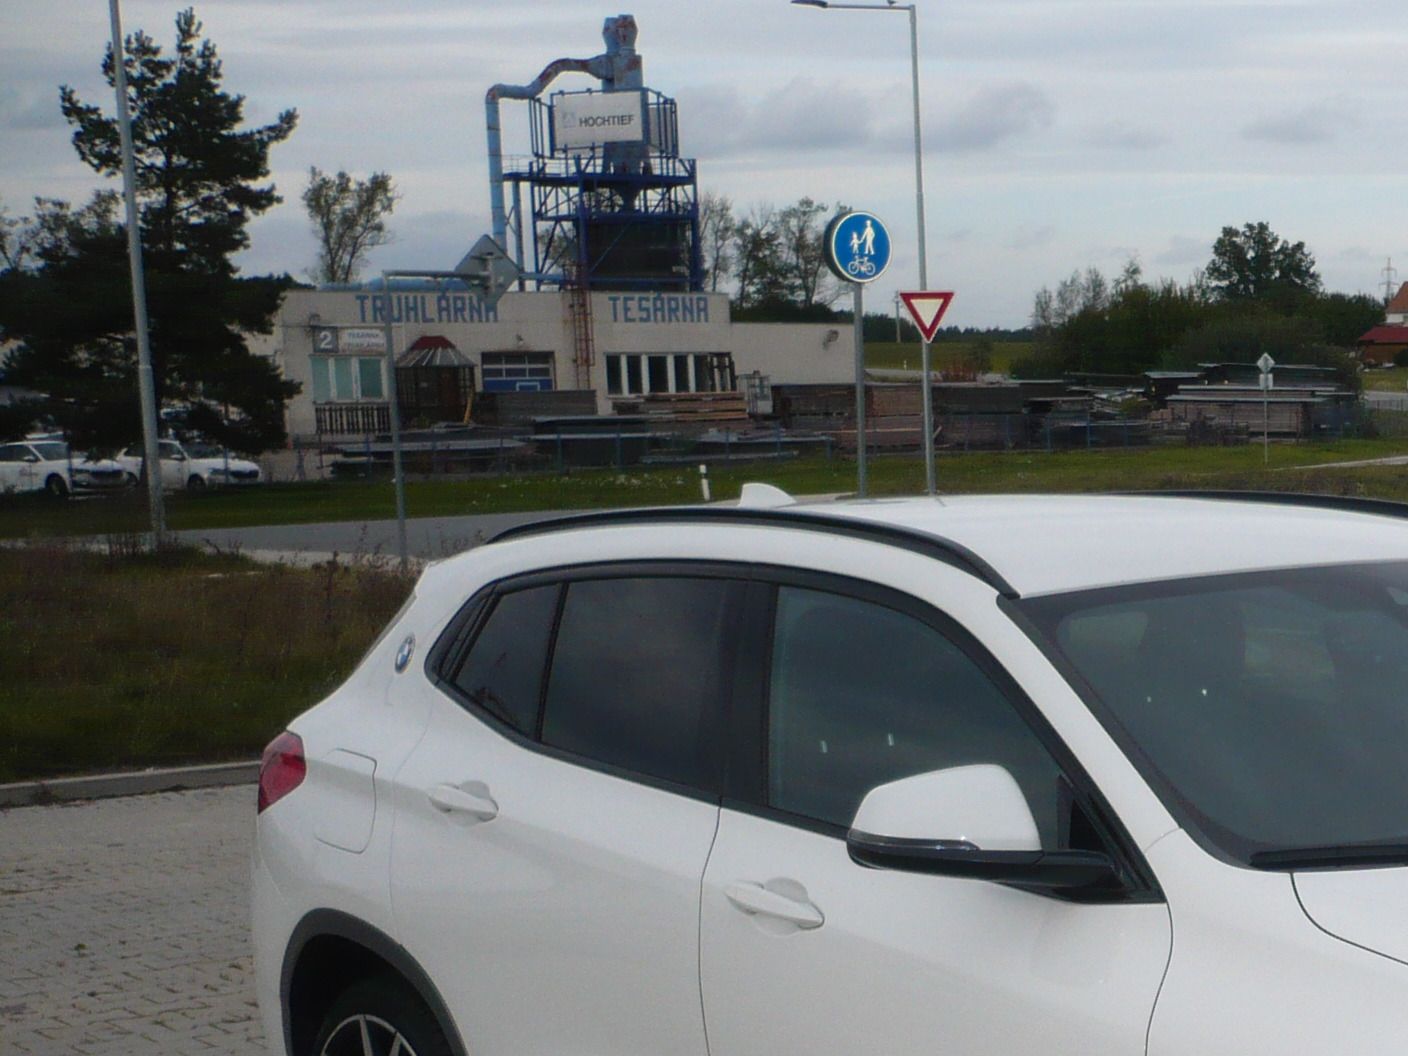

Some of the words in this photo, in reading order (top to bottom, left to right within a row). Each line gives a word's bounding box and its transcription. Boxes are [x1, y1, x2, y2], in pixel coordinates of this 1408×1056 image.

[579, 114, 634, 127] HOCHTIEF
[608, 291, 709, 323] TESÁRNA
[320, 331, 333, 349] 2
